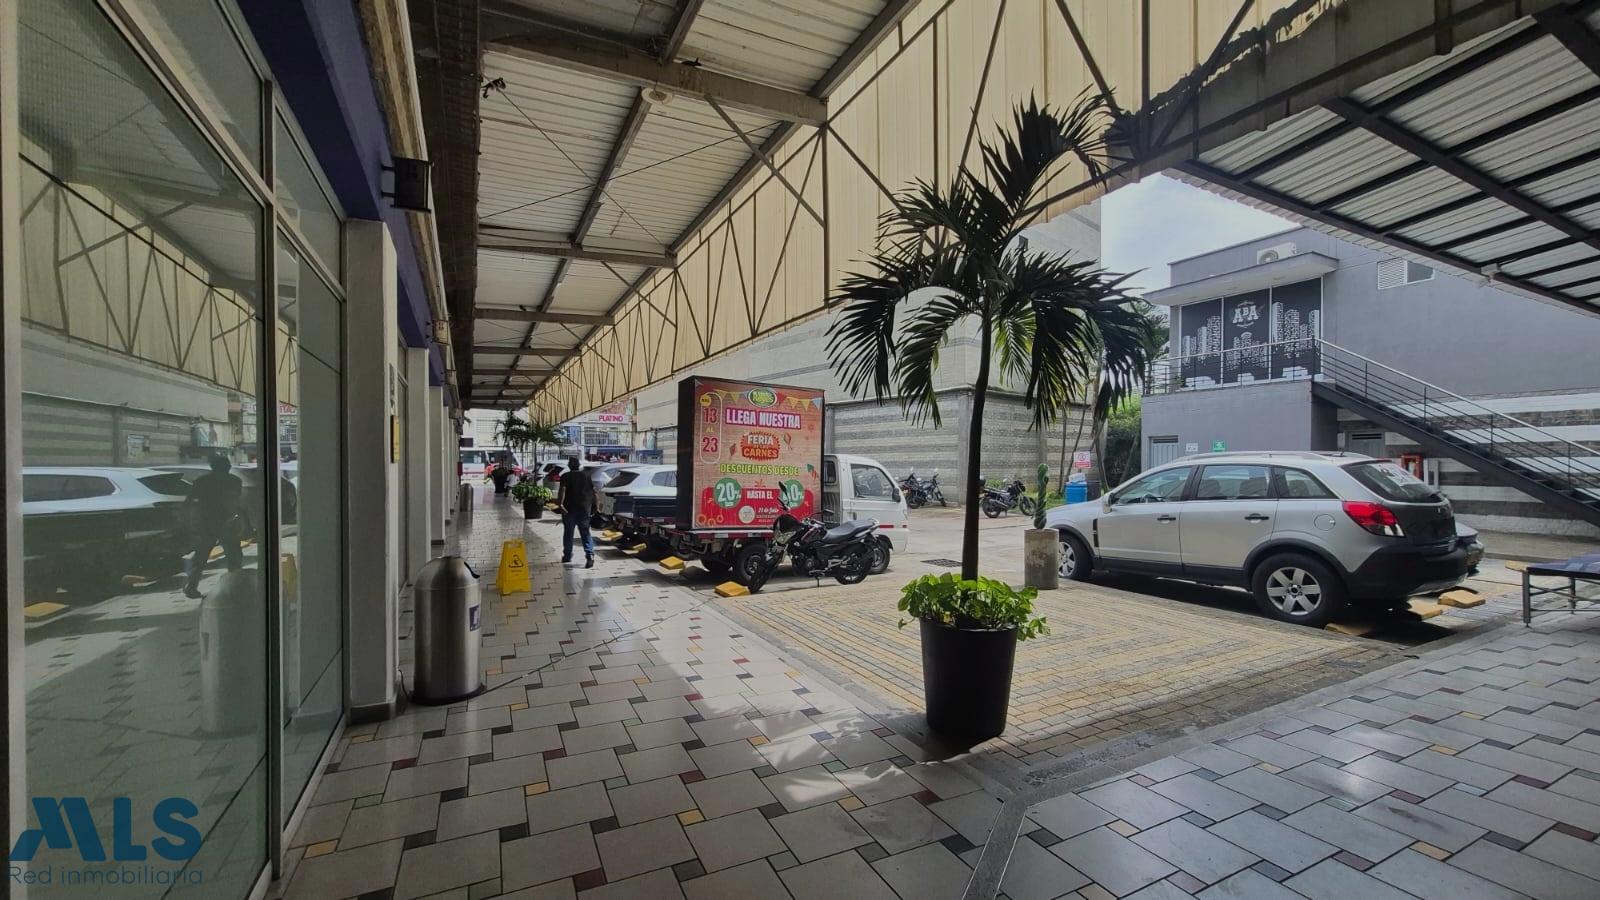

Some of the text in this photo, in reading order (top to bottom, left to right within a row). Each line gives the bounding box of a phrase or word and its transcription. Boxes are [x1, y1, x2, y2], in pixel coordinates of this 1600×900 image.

[703, 408, 717, 424] 13
[726, 408, 801, 429] LLEGA NUESTRA
[702, 437, 718, 453] 23
[747, 434, 774, 445] FERIA
[743, 448, 777, 458] CARNES
[720, 464, 800, 477] DESCUENTOS DESDE
[747, 490, 774, 500] HASTA EL
